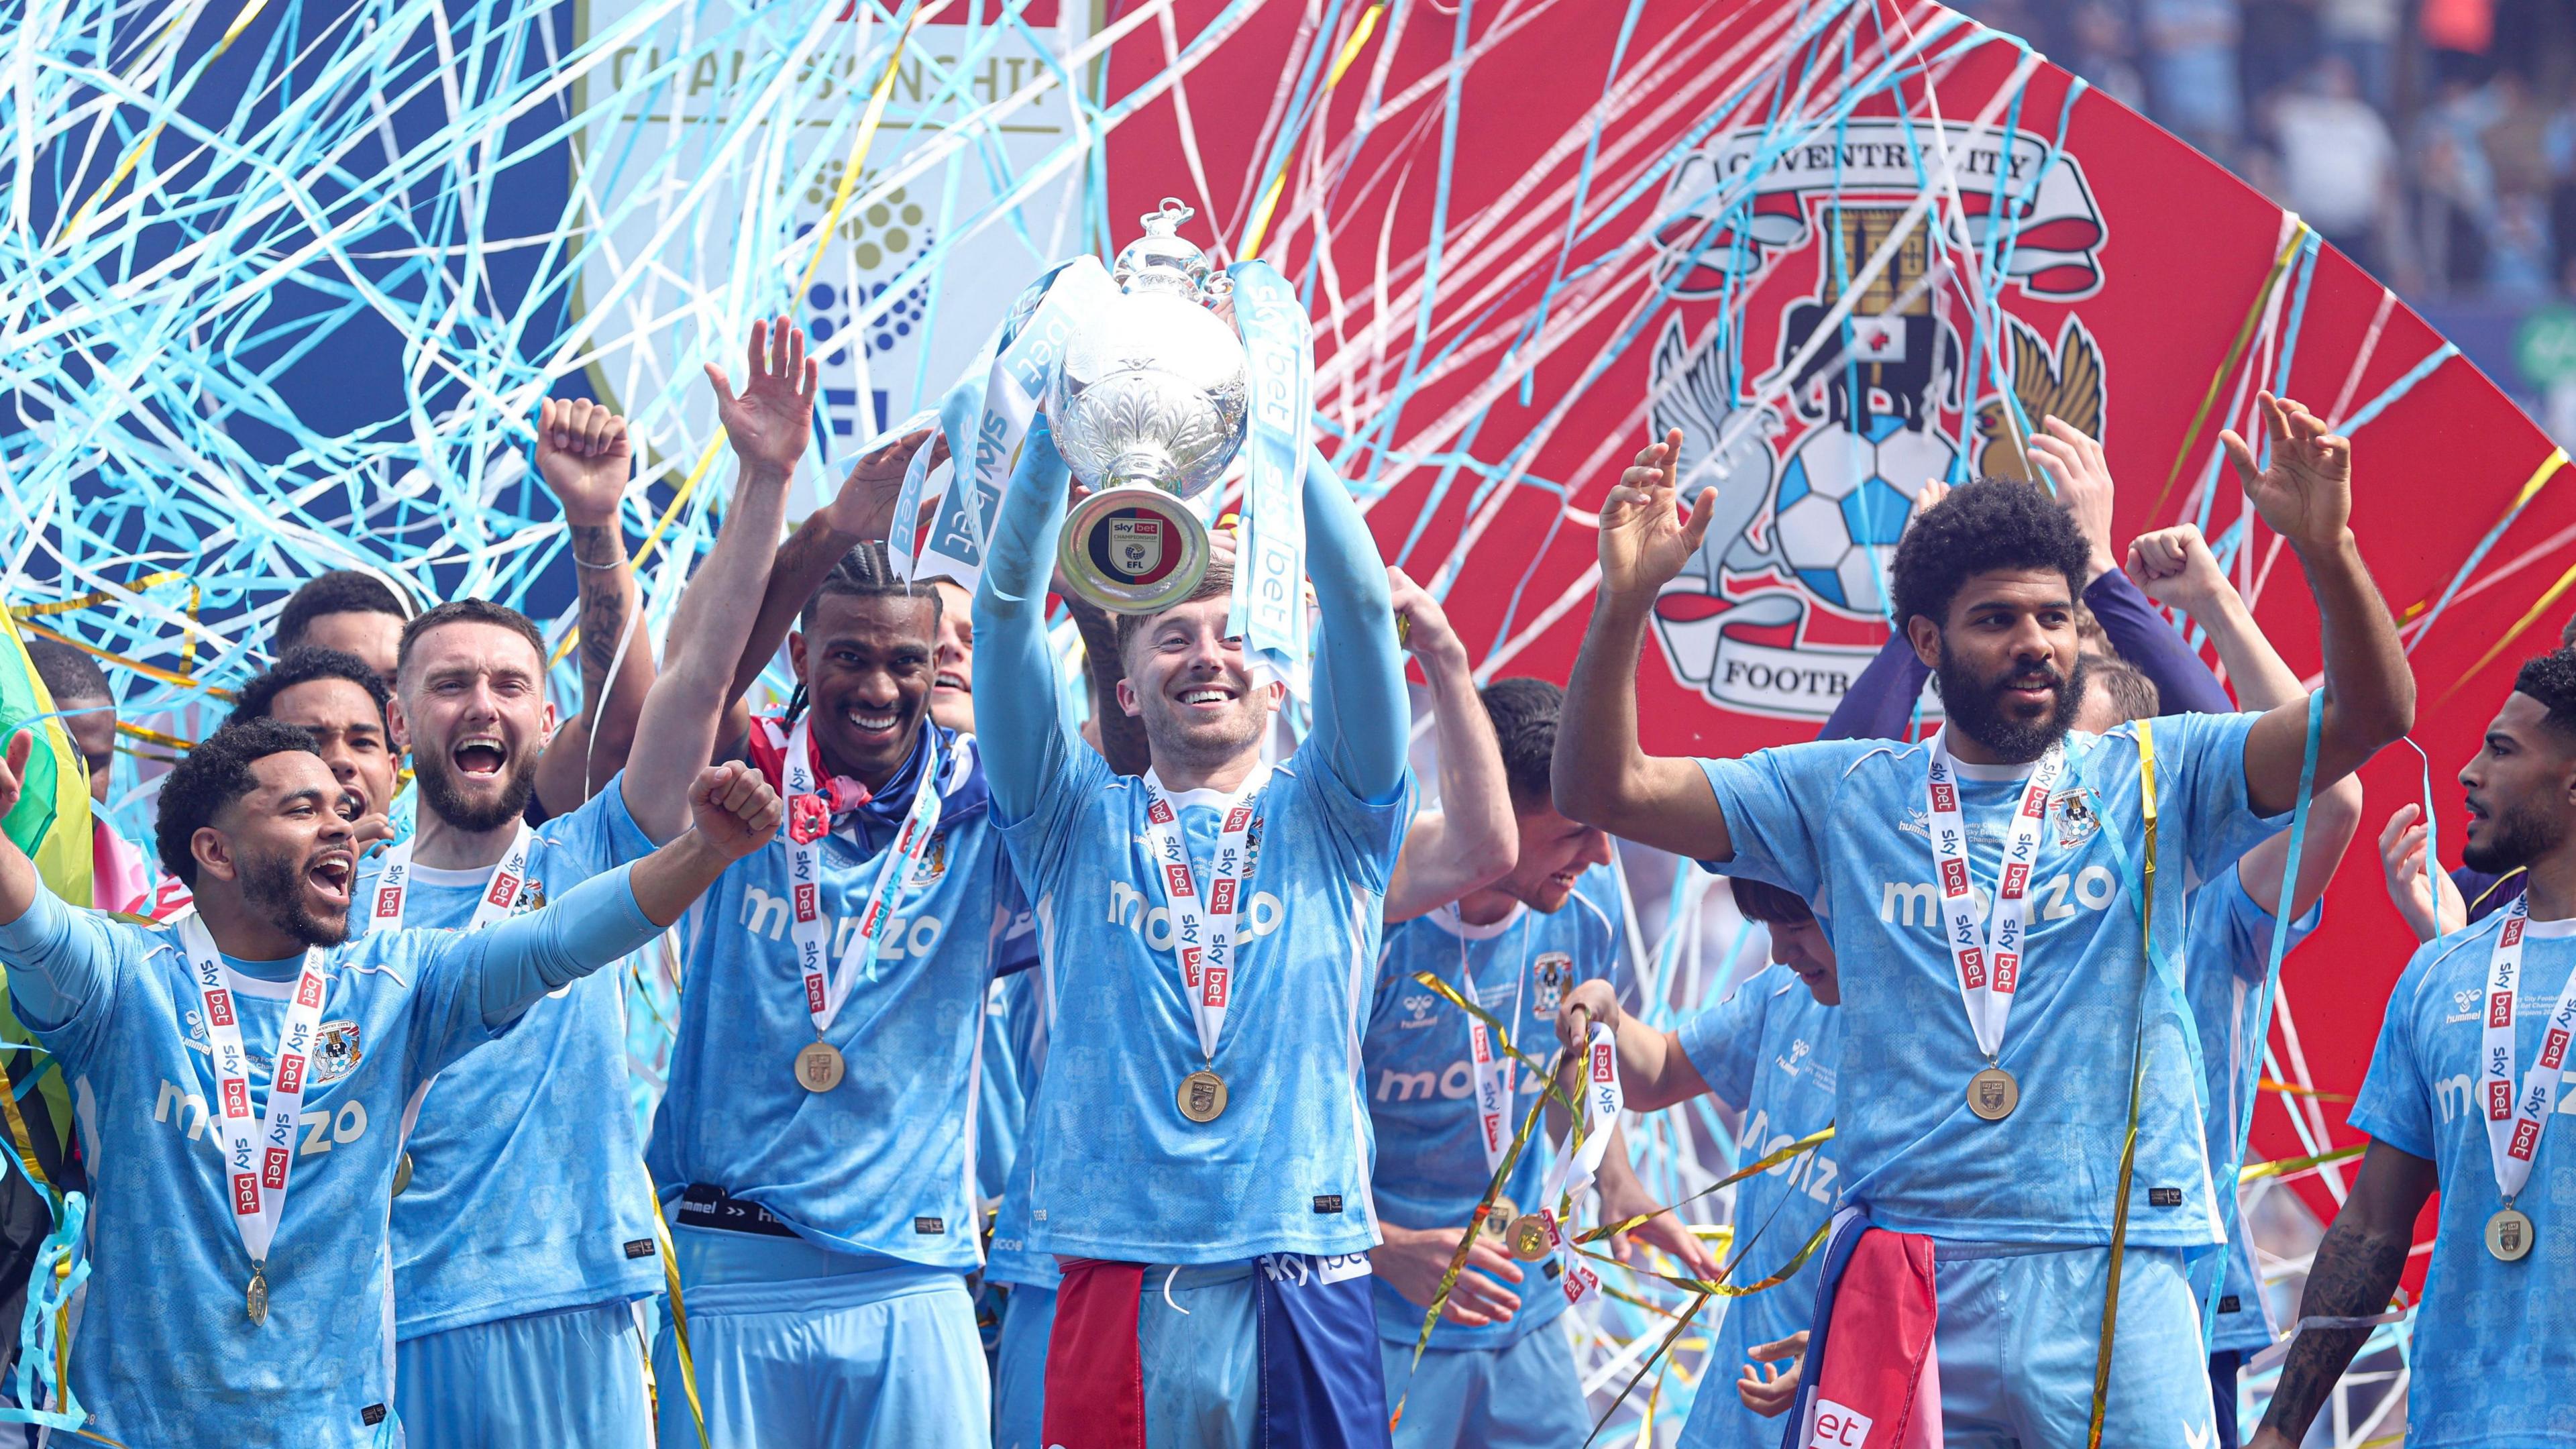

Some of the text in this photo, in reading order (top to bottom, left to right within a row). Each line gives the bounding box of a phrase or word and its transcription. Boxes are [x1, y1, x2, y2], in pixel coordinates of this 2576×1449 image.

[612, 46, 1061, 106] CAINSHIP
[1729, 141, 2032, 181] CVENTRY ITY
[1267, 350, 1292, 421] bet
[896, 468, 922, 544] bet
[1114, 523, 1156, 532] sky bet
[1126, 561, 1143, 569] EFL
[1263, 548, 1291, 623] bet
[1725, 659, 1849, 696] FOOTB
[790, 767, 808, 792] sky
[1929, 761, 1953, 809] sky bet
[2028, 788, 2049, 816] bet
[1152, 802, 1171, 822] bet
[1228, 808, 1250, 830] bet
[1898, 820, 1931, 839] humm
[382, 865, 404, 915] sky bet
[493, 853, 525, 904] sky bet
[795, 851, 812, 918] sky bet
[1164, 836, 1190, 894] sky bet
[1215, 848, 1238, 911] sky bet
[1940, 830, 1964, 895] sky bet
[2006, 833, 2033, 896] sky bet
[1108, 879, 1284, 951] mozo
[1881, 865, 2116, 927] mzo
[1181, 914, 1199, 944] sky
[1955, 914, 1982, 985] sky bet
[1997, 918, 2019, 989] sky bet
[2505, 918, 2524, 946] bet
[200, 959, 230, 1023] sky bet
[302, 977, 321, 1006] bet
[803, 941, 822, 1010] sky bet
[1208, 934, 1228, 1004] sky bet
[2494, 963, 2514, 1025] sky bet
[182, 1035, 213, 1056] ummel
[2446, 1010, 2481, 1024] hummel
[223, 1044, 244, 1114] sky bet
[282, 1022, 309, 1089] sky bet
[2545, 1033, 2567, 1065] bet
[1595, 1047, 1616, 1114] sky bet
[2490, 1046, 2509, 1117] sky bet
[154, 1078, 368, 1156] mzo
[2514, 1085, 2546, 1156] sky bet
[233, 1138, 257, 1211] sky bet
[267, 1113, 291, 1185] sky bet
[1742, 1108, 1842, 1205] onz
[682, 1200, 717, 1214] mmel
[1564, 1273, 1581, 1299] et
[1816, 1413, 1859, 1447] et
